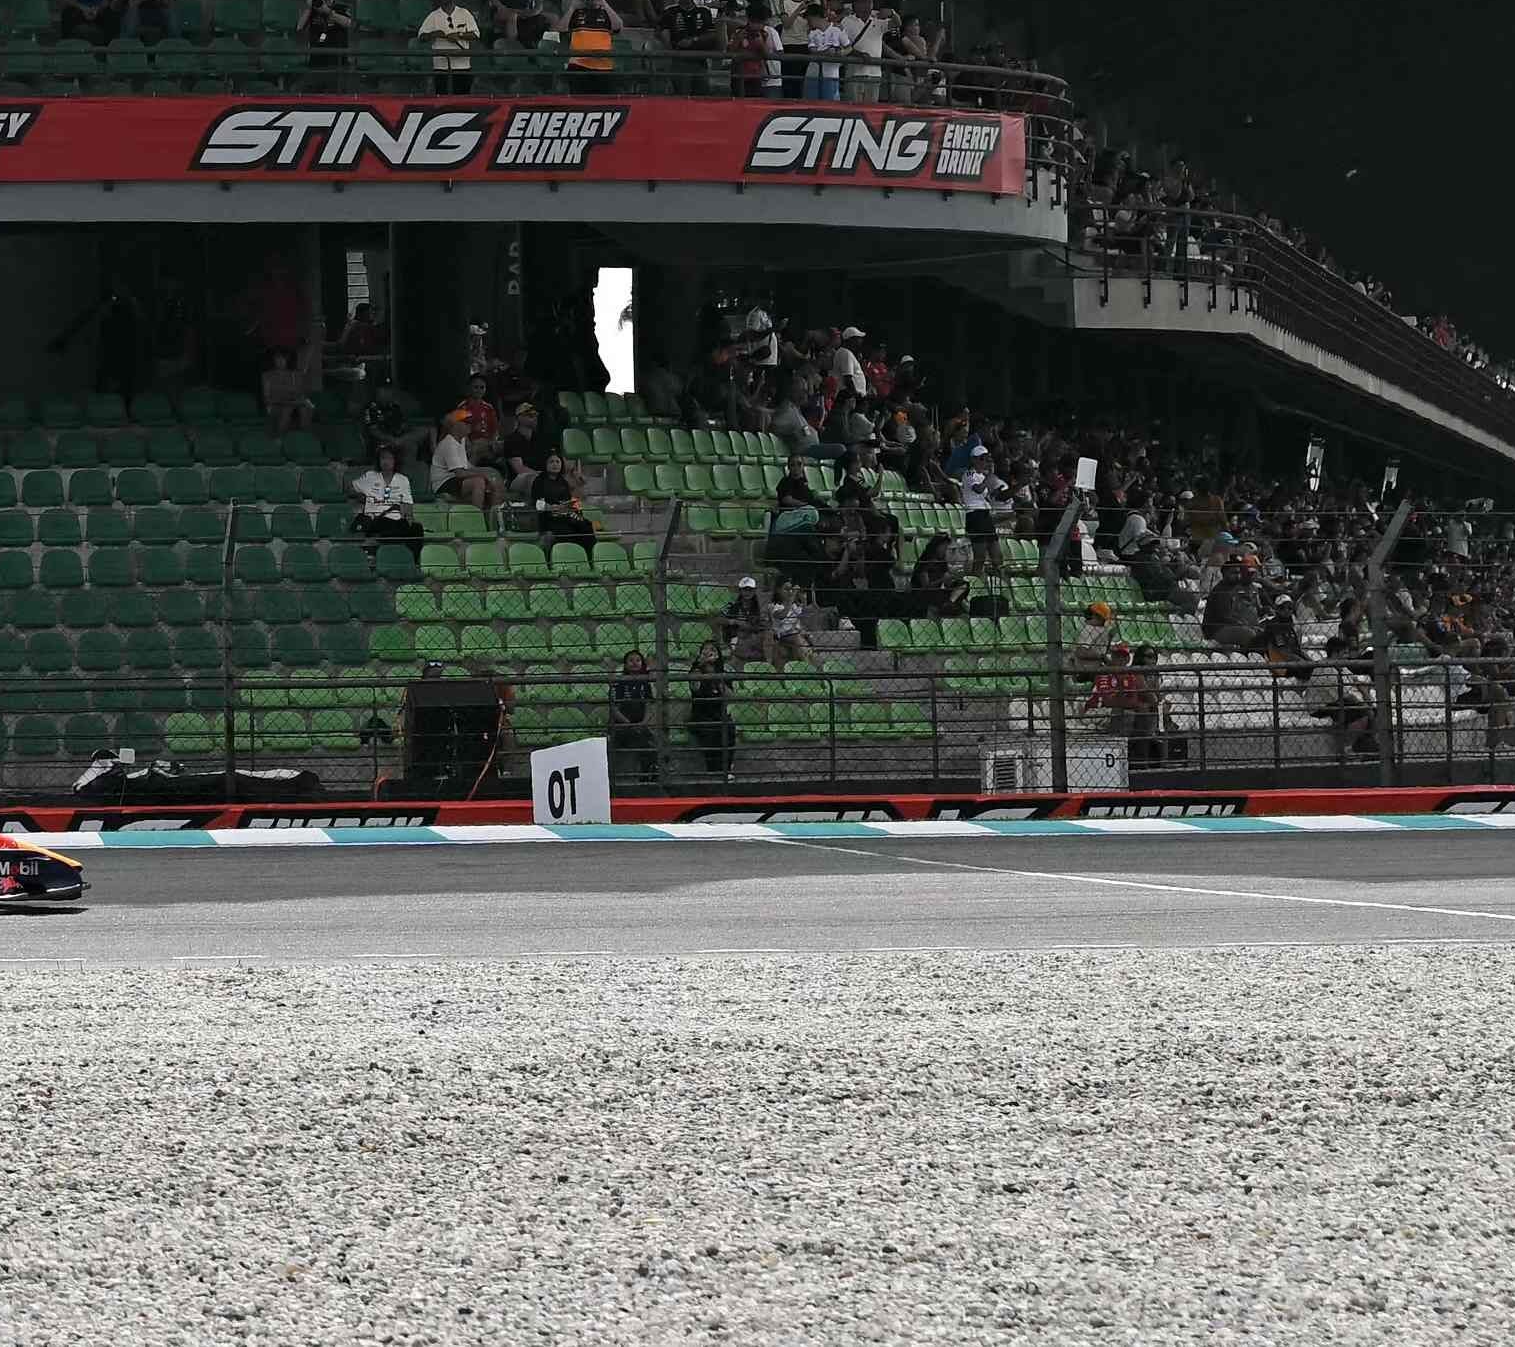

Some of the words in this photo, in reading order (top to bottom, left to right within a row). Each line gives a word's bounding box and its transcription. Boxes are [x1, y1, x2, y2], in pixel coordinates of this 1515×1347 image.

[199, 110, 483, 165] STING
[507, 111, 622, 138] ENERGY
[942, 122, 1000, 152] ENERGY
[495, 137, 588, 165] DRINK
[749, 116, 930, 172] STING
[935, 149, 986, 176] DRINK
[548, 765, 580, 820] OT
